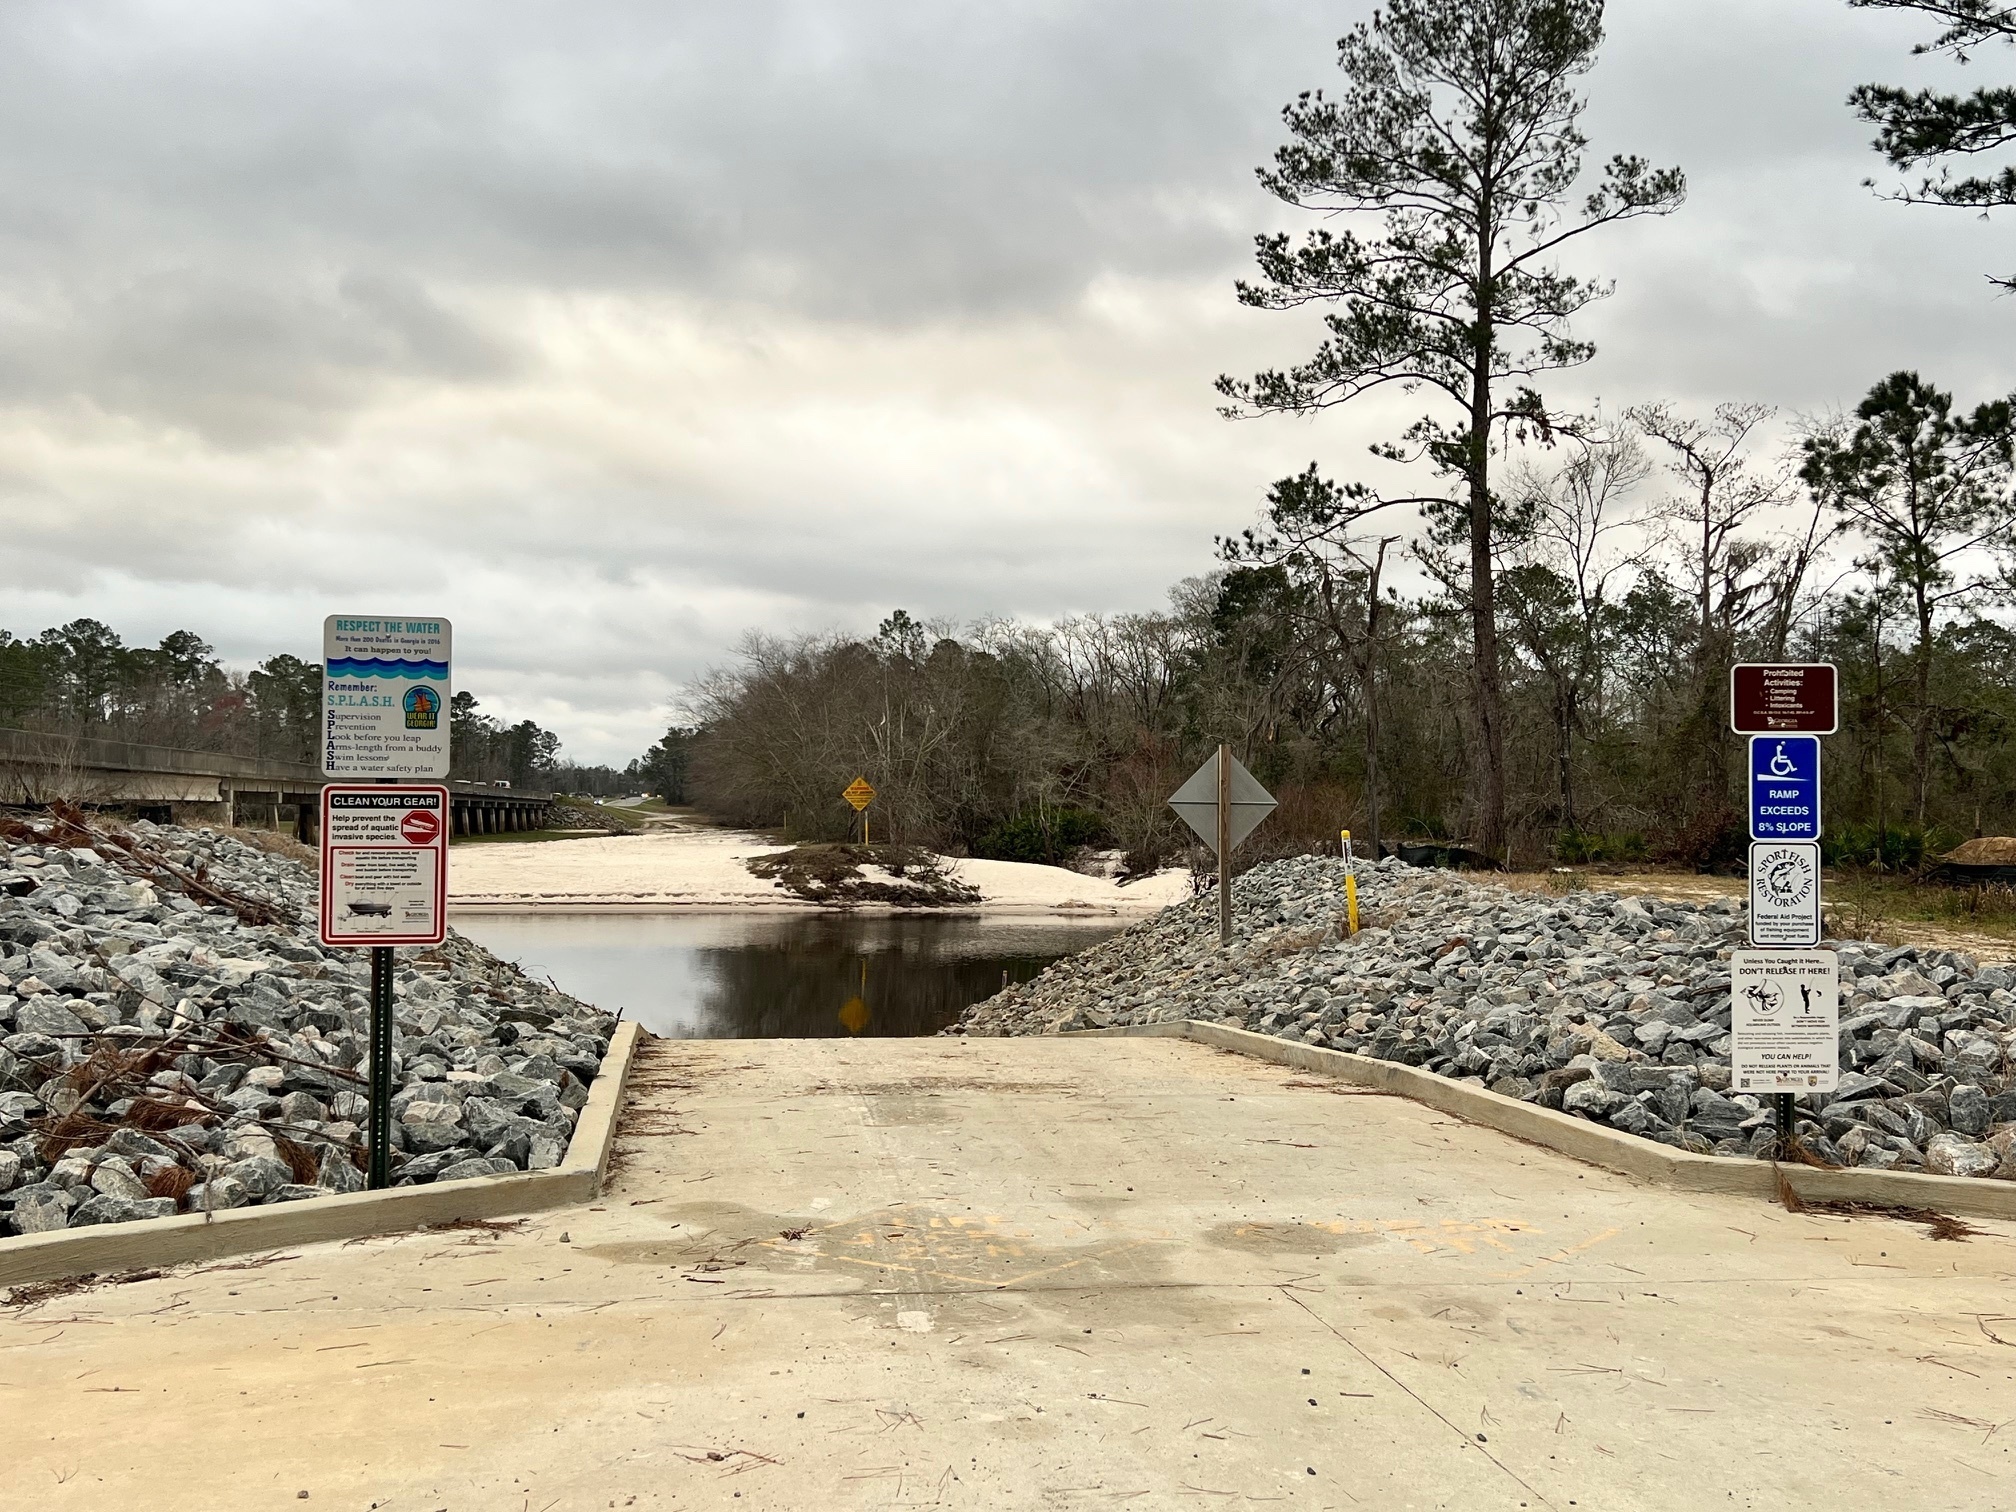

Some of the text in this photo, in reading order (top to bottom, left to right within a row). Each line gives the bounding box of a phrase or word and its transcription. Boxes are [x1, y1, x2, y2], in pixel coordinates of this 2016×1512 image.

[336, 620, 440, 634] RESPECT THE WATER
[401, 637, 418, 646] Georgia
[371, 646, 401, 654] happen
[328, 681, 377, 692] Remember:
[327, 695, 395, 707] S.P.L.A.S.H.
[328, 710, 381, 721] Supervision
[327, 720, 376, 731] Prevention
[327, 731, 352, 740] Look
[403, 734, 421, 743] leap
[326, 741, 382, 752] Arms-length
[416, 745, 442, 753] buddy
[327, 751, 354, 761] Swim
[326, 761, 350, 771] Have
[386, 765, 412, 774] safety
[1769, 790, 1799, 799] RAMP
[334, 797, 437, 806] CLEAN YOUR GEAR!
[1760, 806, 1809, 815] EXCEEDS
[1759, 822, 1811, 831] 8% SLOPE
[1758, 848, 1812, 874] SPORT FISH
[1756, 878, 1813, 907] RESTORATION
